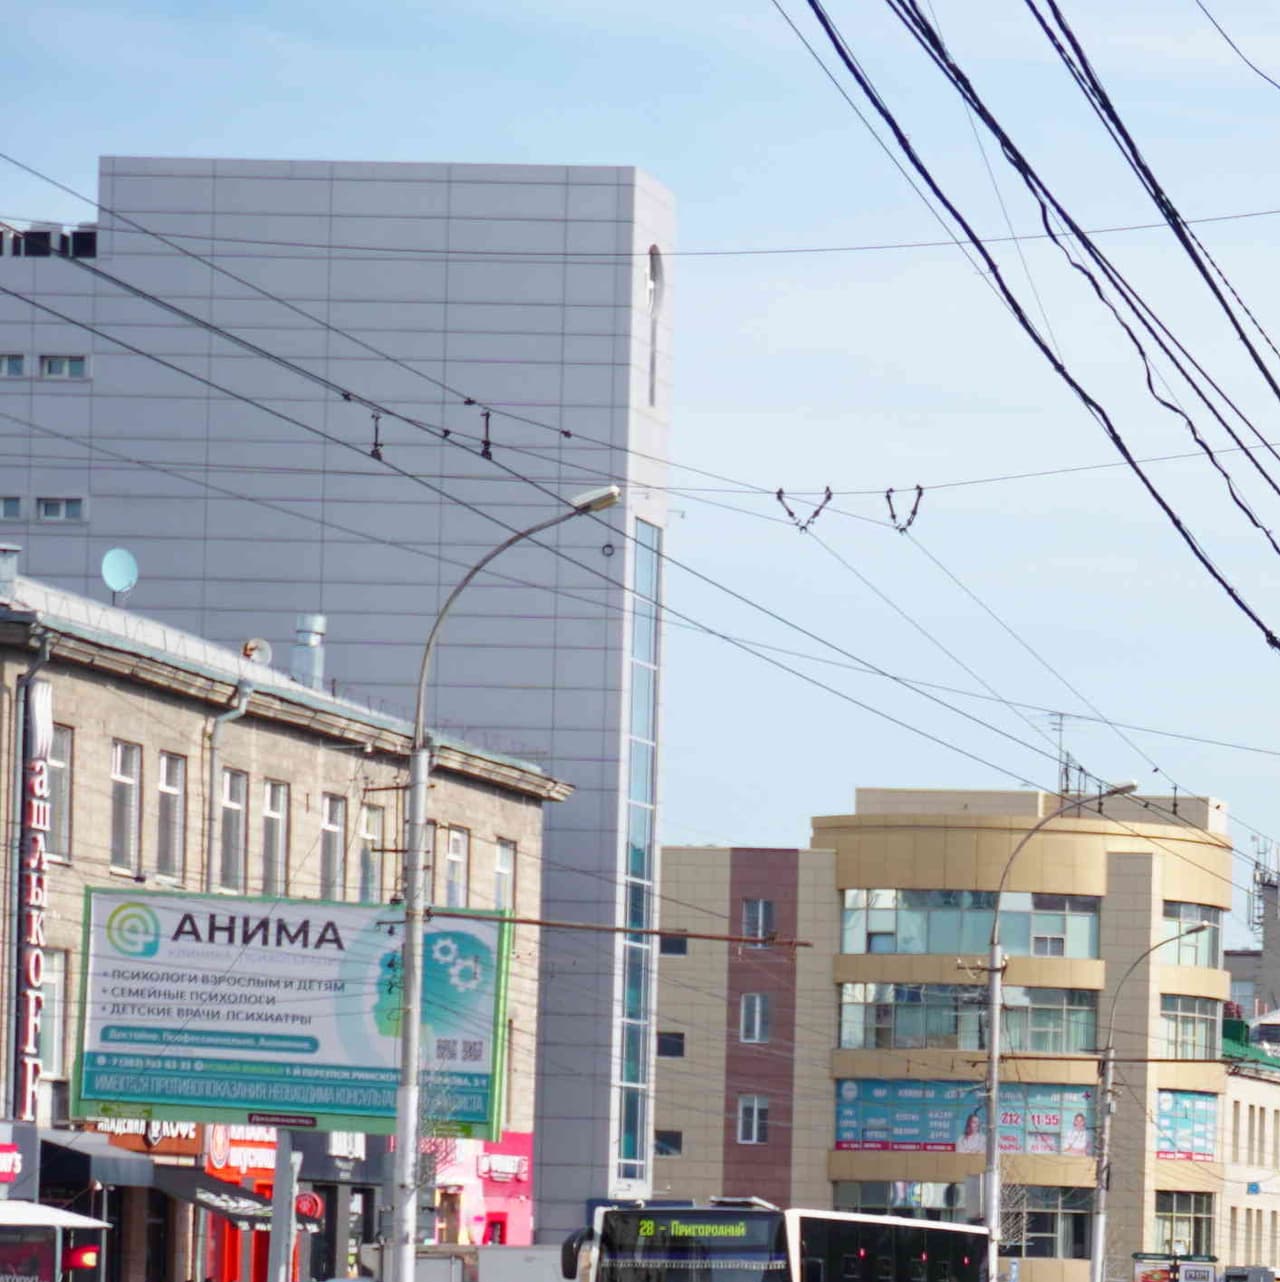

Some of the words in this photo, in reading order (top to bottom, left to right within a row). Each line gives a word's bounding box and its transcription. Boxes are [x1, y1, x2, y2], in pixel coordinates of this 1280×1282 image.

[171, 913, 346, 951] АНИМА
[112, 970, 199, 984] ПСИХОЛОГИ
[201, 974, 282, 989] ВЗРОСЛЫМ
[284, 979, 294, 989] И
[296, 979, 346, 993] ДЕТЯМ
[111, 986, 188, 1001] СЕМЕЙНЫЕ
[190, 991, 277, 1006] ПСИХОЛОГИ
[109, 1003, 173, 1018] ДЕТСКИЕ
